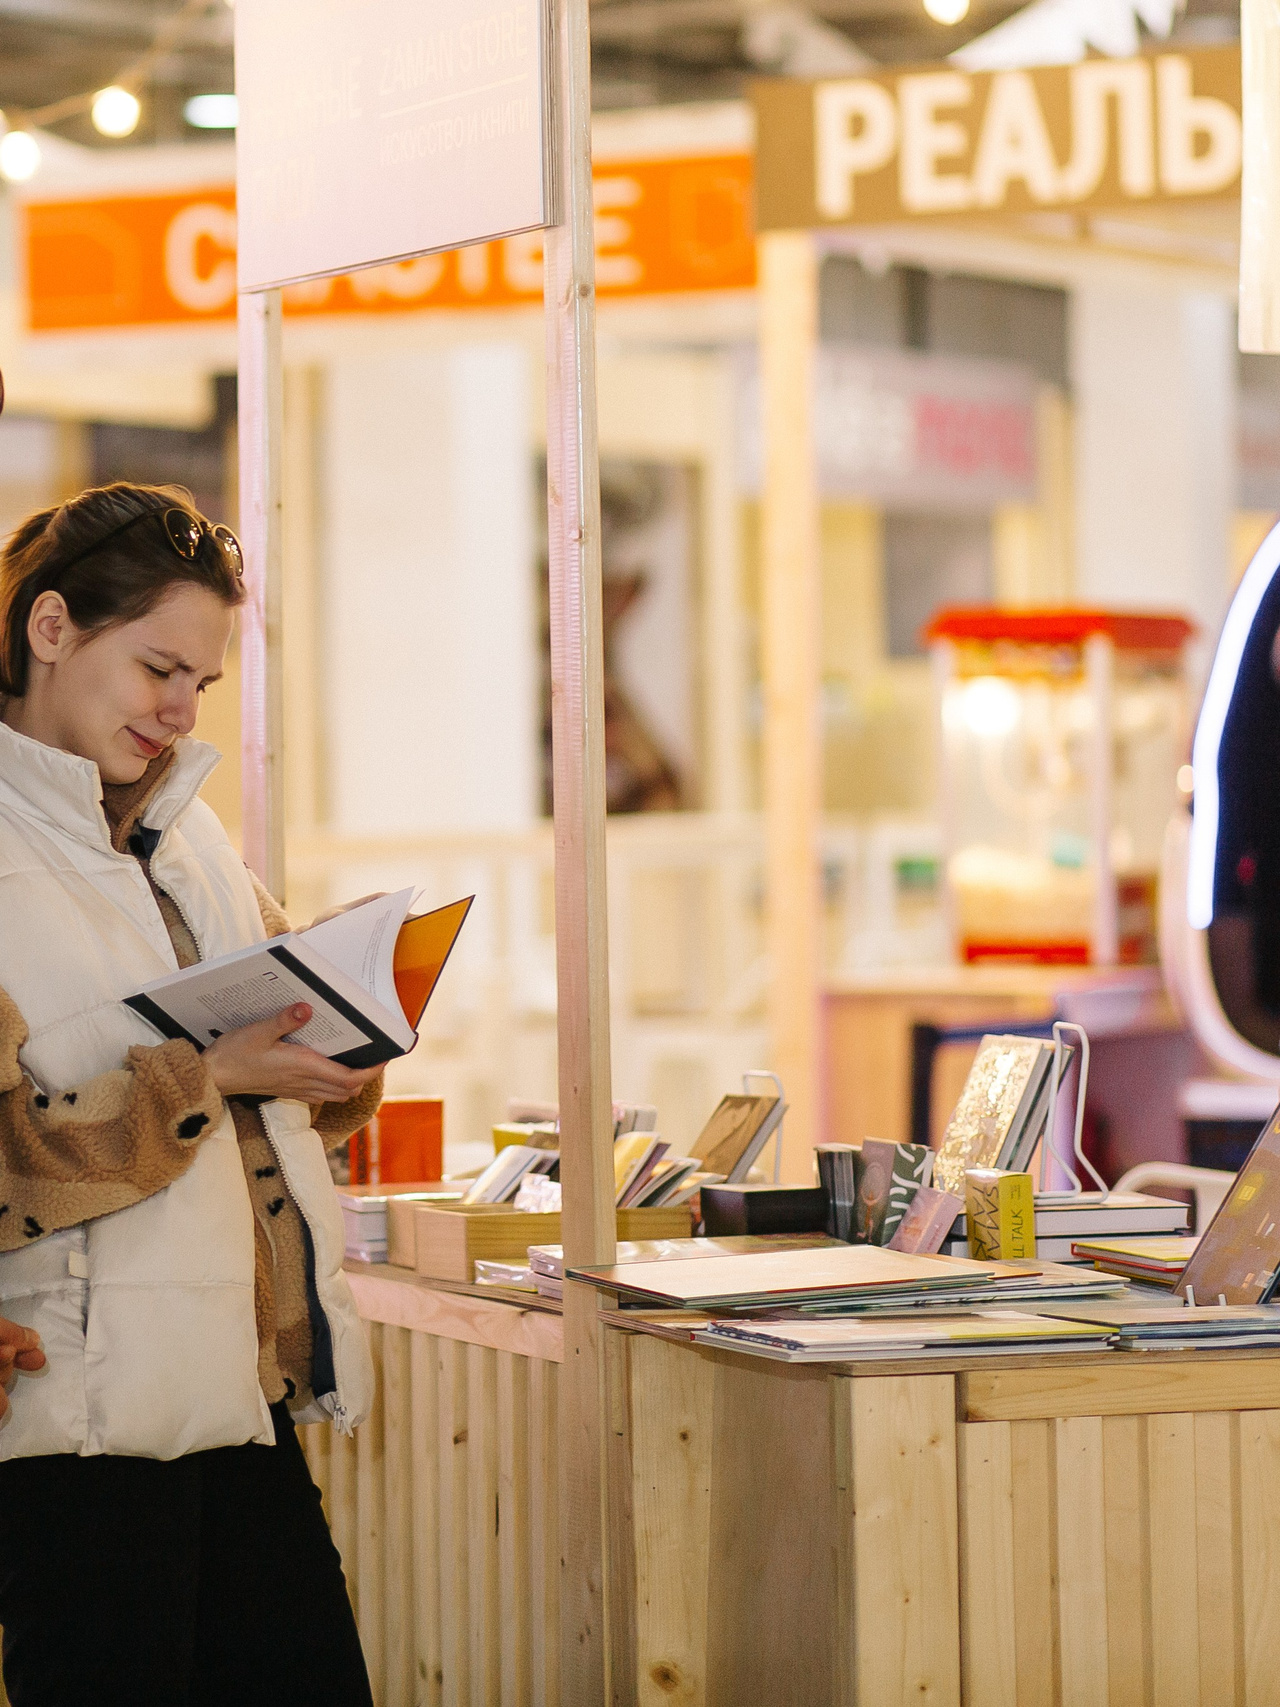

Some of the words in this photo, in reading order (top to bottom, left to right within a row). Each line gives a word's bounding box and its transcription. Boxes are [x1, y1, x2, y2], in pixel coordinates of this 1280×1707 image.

[378, 29, 455, 97] ZAMAN
[459, 5, 530, 75] STORE
[378, 116, 465, 168] ИСКУССТВО
[466, 113, 478, 147] И
[481, 97, 531, 142] КНИГИ
[1011, 1209, 1024, 1240] TALK
